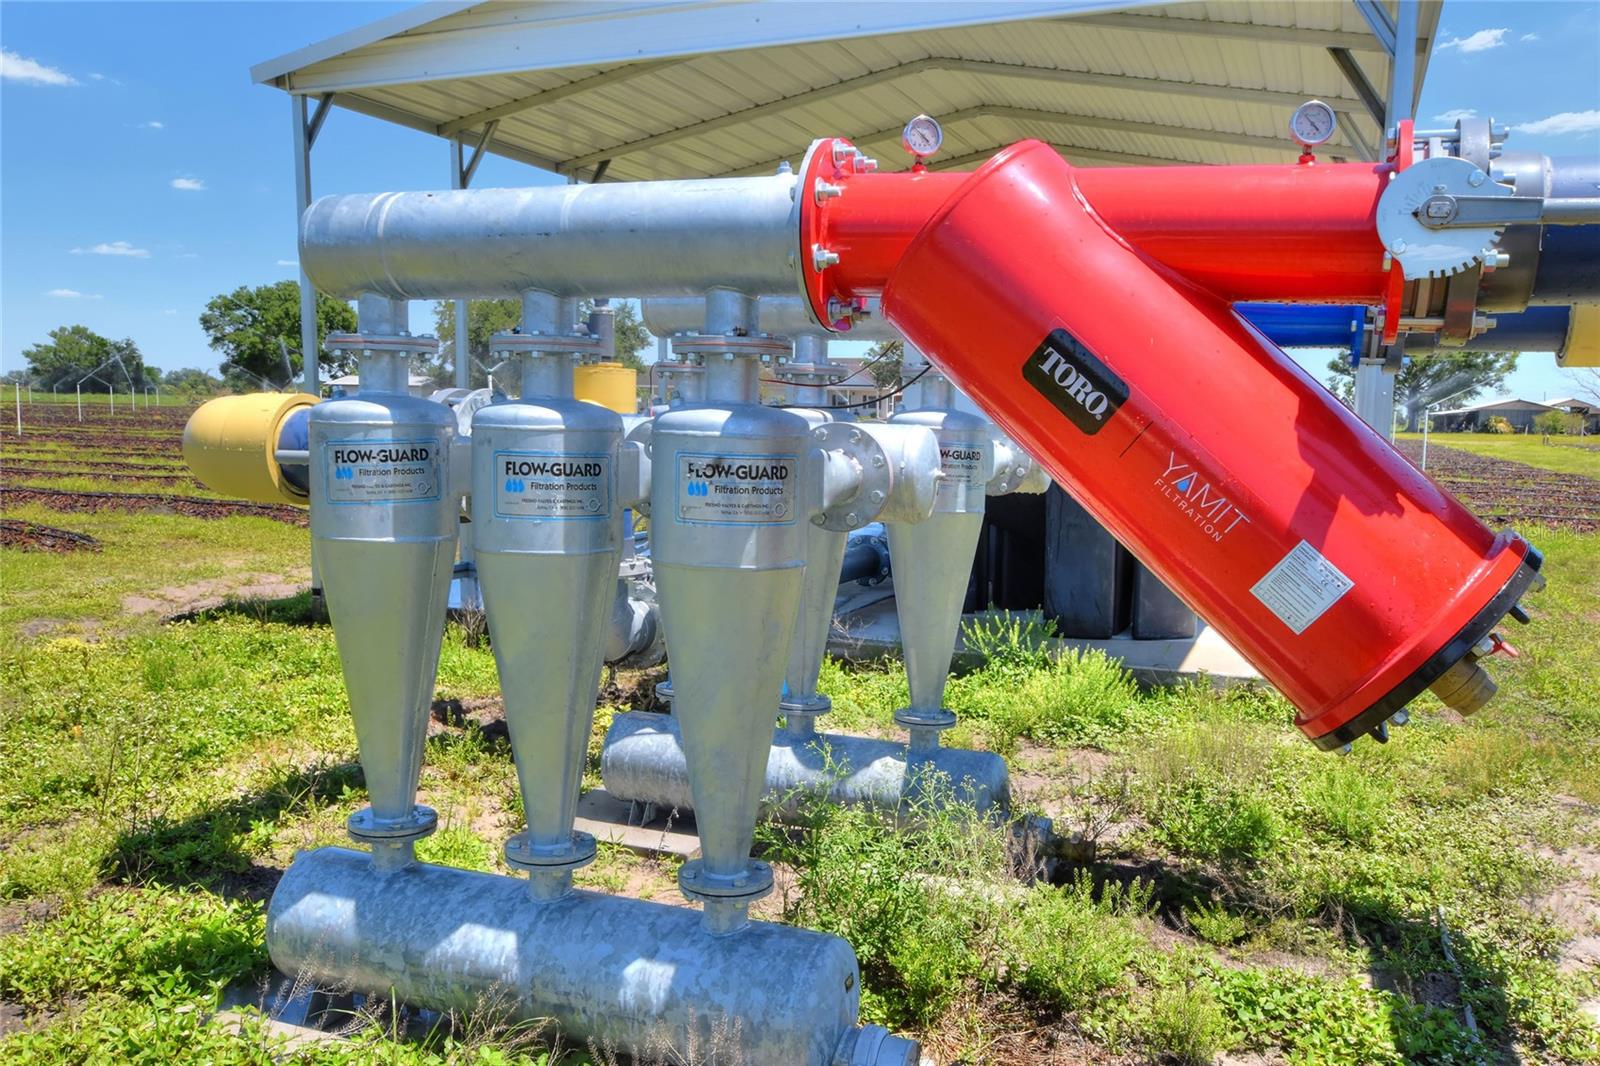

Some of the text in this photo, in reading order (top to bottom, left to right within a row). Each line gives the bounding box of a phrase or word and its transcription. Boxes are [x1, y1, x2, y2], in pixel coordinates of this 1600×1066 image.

[1038, 346, 1109, 415] TORO
[335, 448, 429, 464] FLOW-GUARD
[939, 449, 981, 461] W-GUARD
[359, 467, 425, 477] Filtration Products
[505, 461, 602, 477] FLOW-GUARD
[688, 462, 789, 480] FLOW-GUARD
[530, 481, 598, 491] Filtration Products
[714, 485, 784, 496] Filtration Products
[1162, 451, 1251, 534] YAMIT
[1154, 478, 1223, 542] FILTRATION
